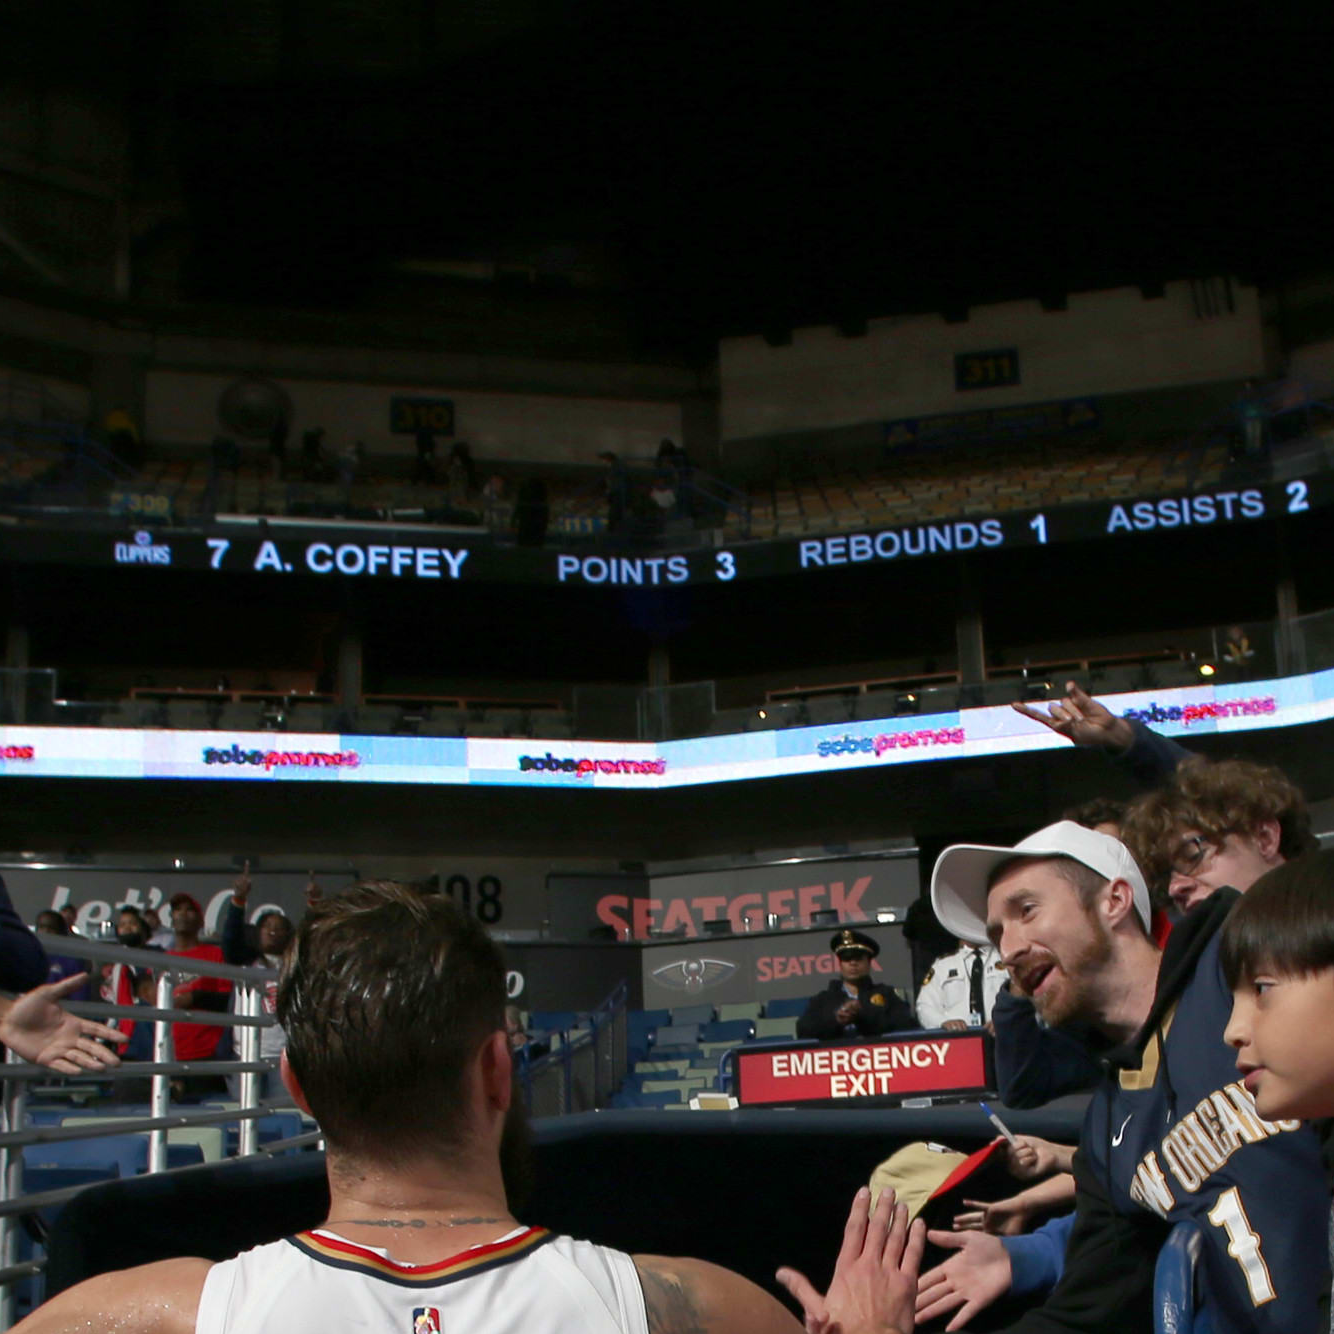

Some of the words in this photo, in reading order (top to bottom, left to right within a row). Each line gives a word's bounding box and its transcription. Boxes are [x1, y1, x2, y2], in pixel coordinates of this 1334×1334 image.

[207, 540, 225, 569] 7
[255, 542, 292, 572] A.
[306, 544, 468, 579] COFFEY
[557, 554, 689, 585] POINTS
[715, 551, 736, 580] 3
[800, 518, 1004, 568] REBOUNDS
[1029, 514, 1048, 545] 1
[1106, 489, 1265, 534] ASSISTS
[1286, 480, 1309, 513] 2
[596, 876, 873, 941] SEATGEEK
[772, 1042, 951, 1078] EMERGENCY
[830, 1072, 893, 1099] EXIT
[1208, 1186, 1277, 1308] 1
